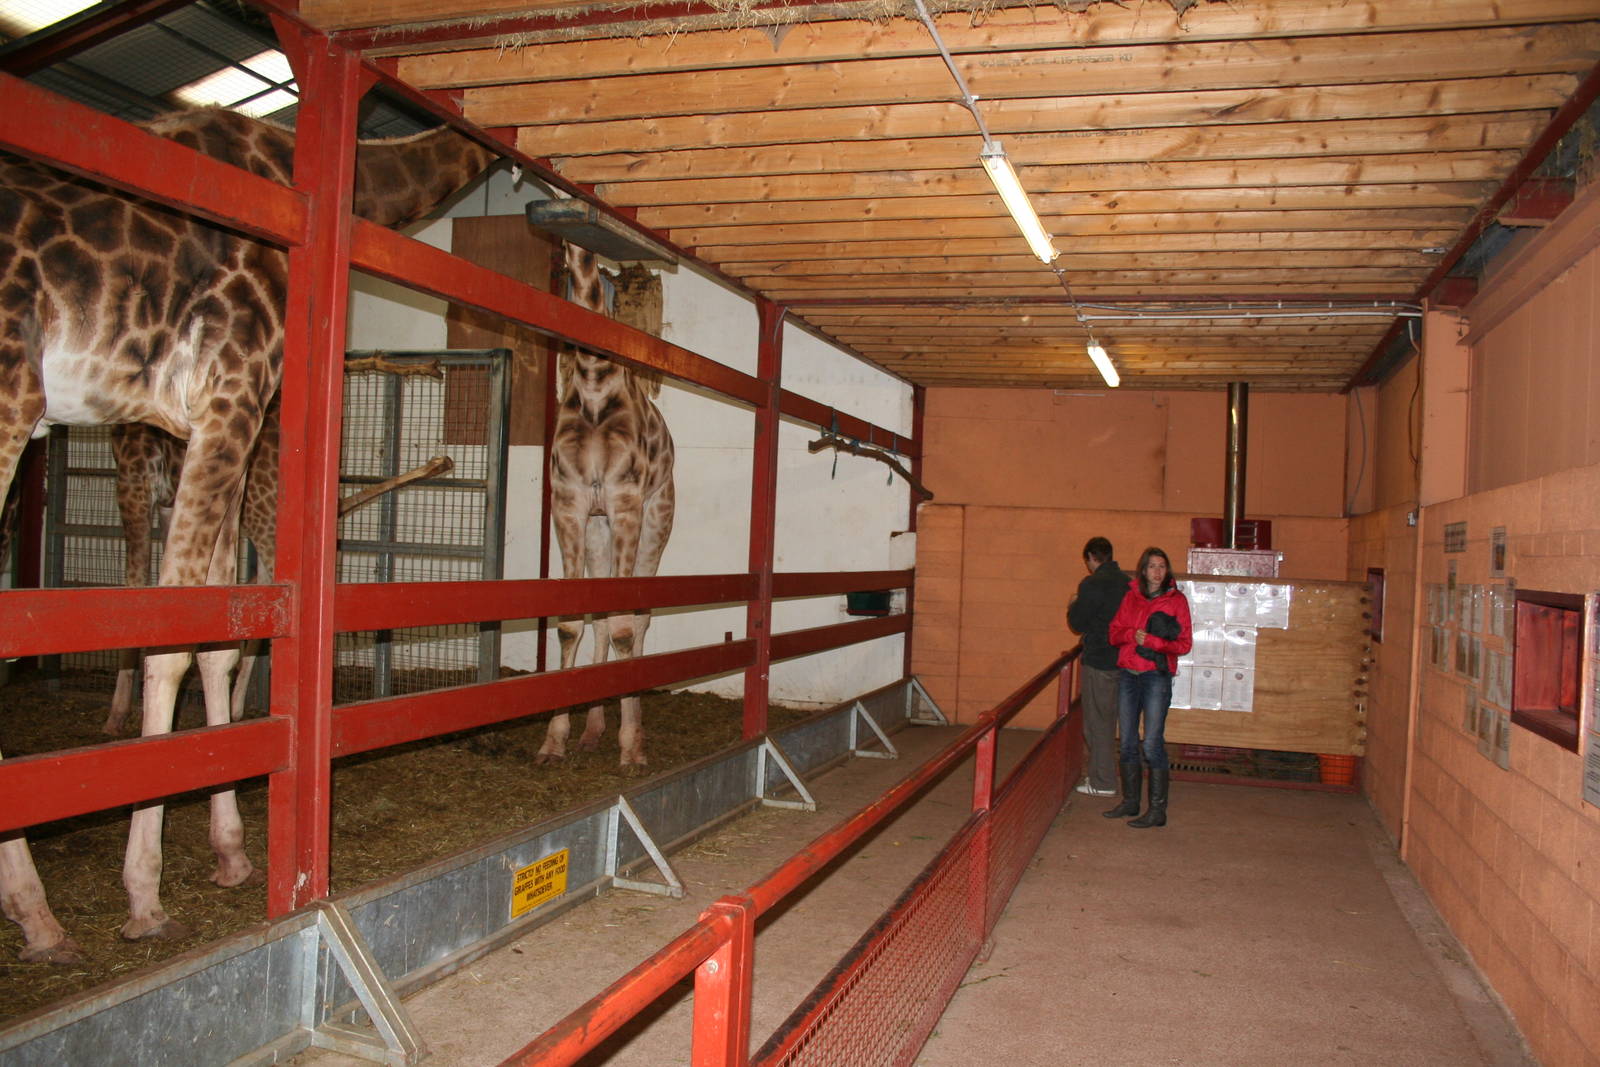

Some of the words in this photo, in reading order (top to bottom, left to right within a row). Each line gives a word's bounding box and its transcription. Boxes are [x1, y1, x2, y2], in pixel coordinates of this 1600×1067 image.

[534, 875, 545, 886] WITH
[545, 870, 554, 880] ANY
[555, 863, 566, 874] FOOD
[535, 864, 542, 875] NO
[543, 857, 558, 870] FEEDING
[526, 881, 552, 901] WHATSOEVER
